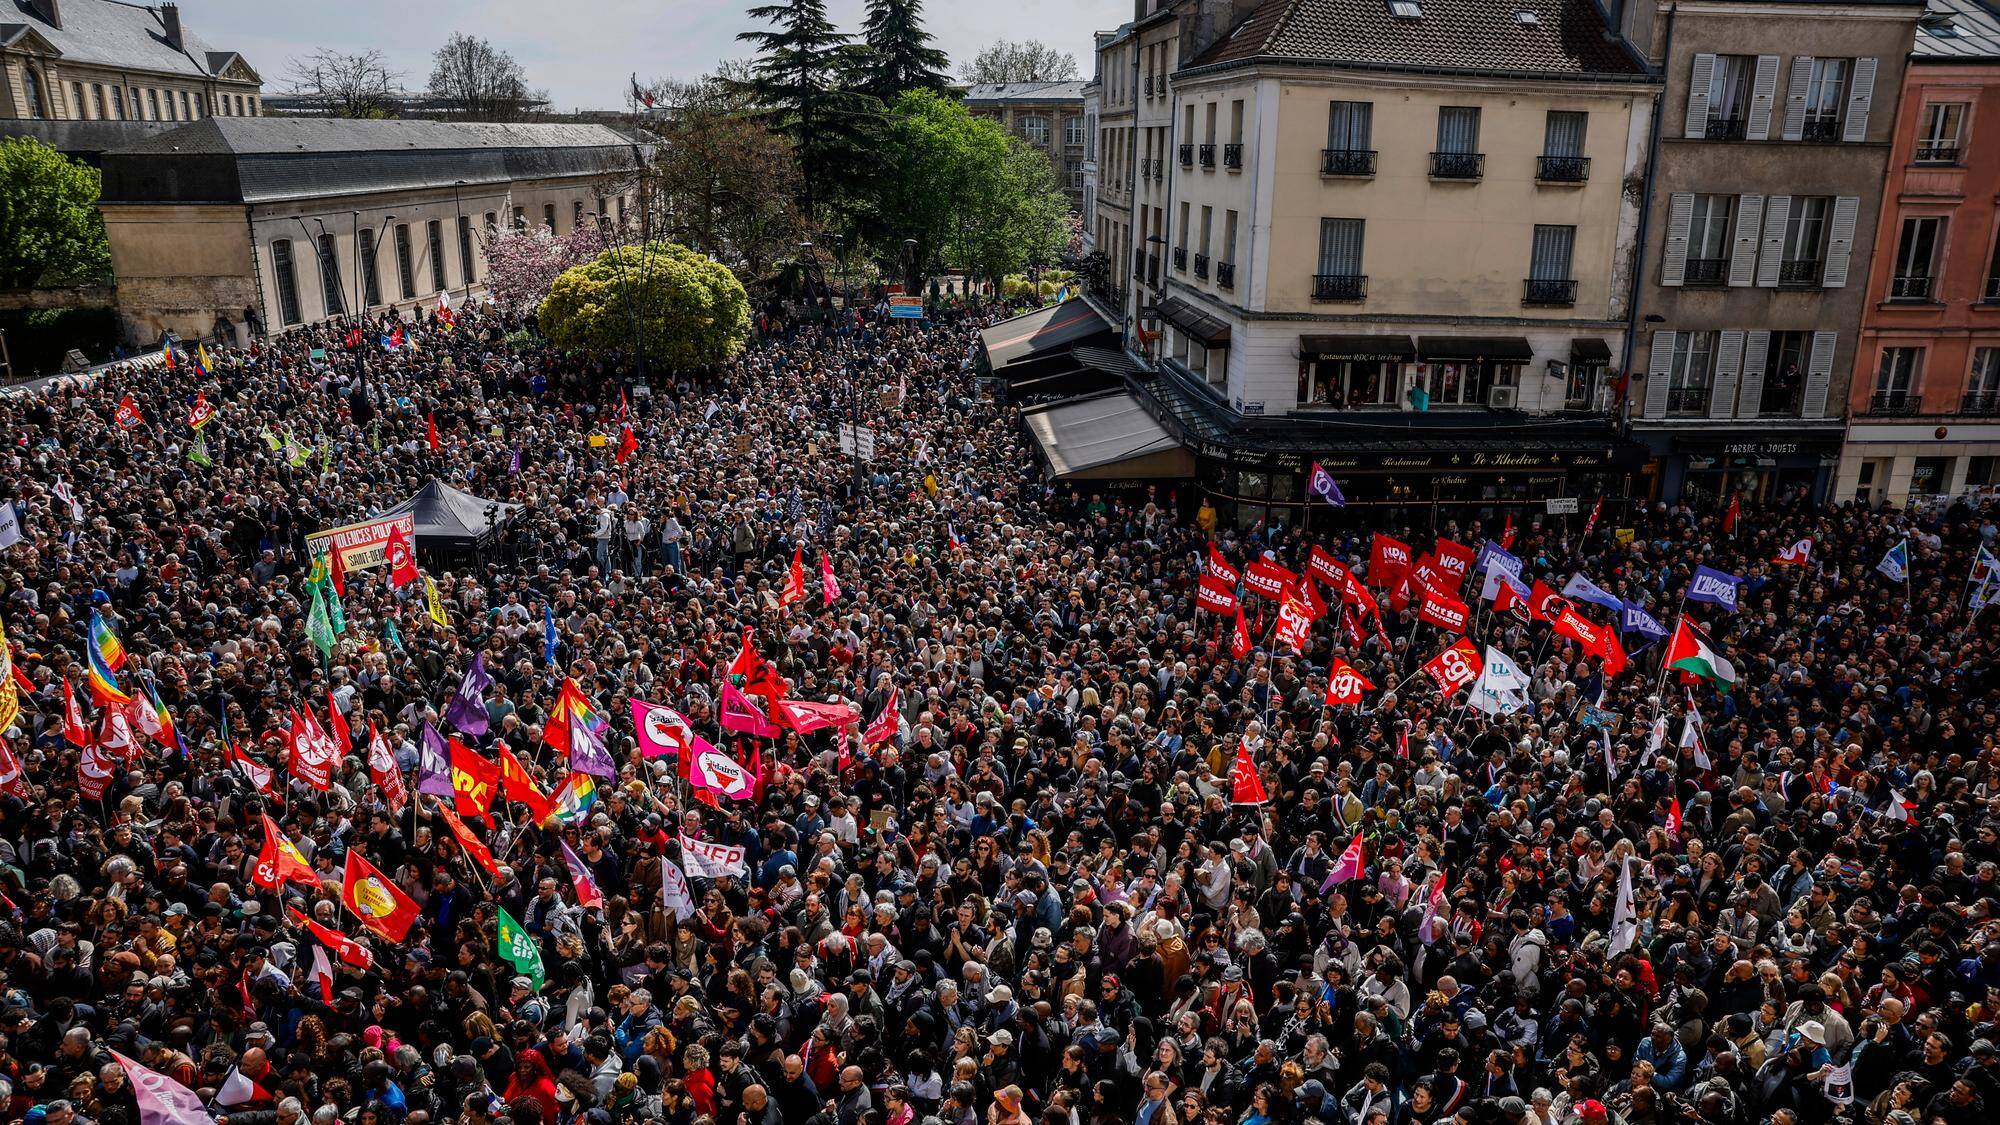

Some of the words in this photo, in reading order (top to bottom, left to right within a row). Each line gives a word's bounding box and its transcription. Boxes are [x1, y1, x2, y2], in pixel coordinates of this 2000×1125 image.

[1319, 353, 1351, 361] Restaurant
[1353, 353, 1368, 361] RDC
[1232, 450, 1267, 458] Restaurant
[1725, 444, 1756, 453] L'ARBRE
[1767, 443, 1797, 453] JOUETS
[1319, 457, 1357, 466] Brasserie
[1382, 456, 1432, 467] Restaurant
[1471, 453, 1487, 466] Le
[1491, 452, 1543, 466] Khedive
[1573, 455, 1598, 466] Tabac
[1440, 476, 1467, 484] Khedive
[309, 538, 331, 555] STOP
[372, 519, 412, 539] POLICRES
[348, 547, 386, 567] SAINT-DEN
[1383, 547, 1408, 562] NPA
[1440, 553, 1466, 571] NPA
[1312, 554, 1344, 577] lutte
[1247, 569, 1283, 589] lutte
[1199, 584, 1233, 605] lutte
[1426, 600, 1464, 622] lutte
[1551, 606, 1561, 615] UC
[1280, 604, 1311, 638] cgt
[1441, 649, 1476, 687] cgt
[1330, 674, 1364, 699] cgt
[648, 713, 684, 724] Sodaires
[704, 753, 740, 776] Sidaires
[257, 862, 276, 882] cg
